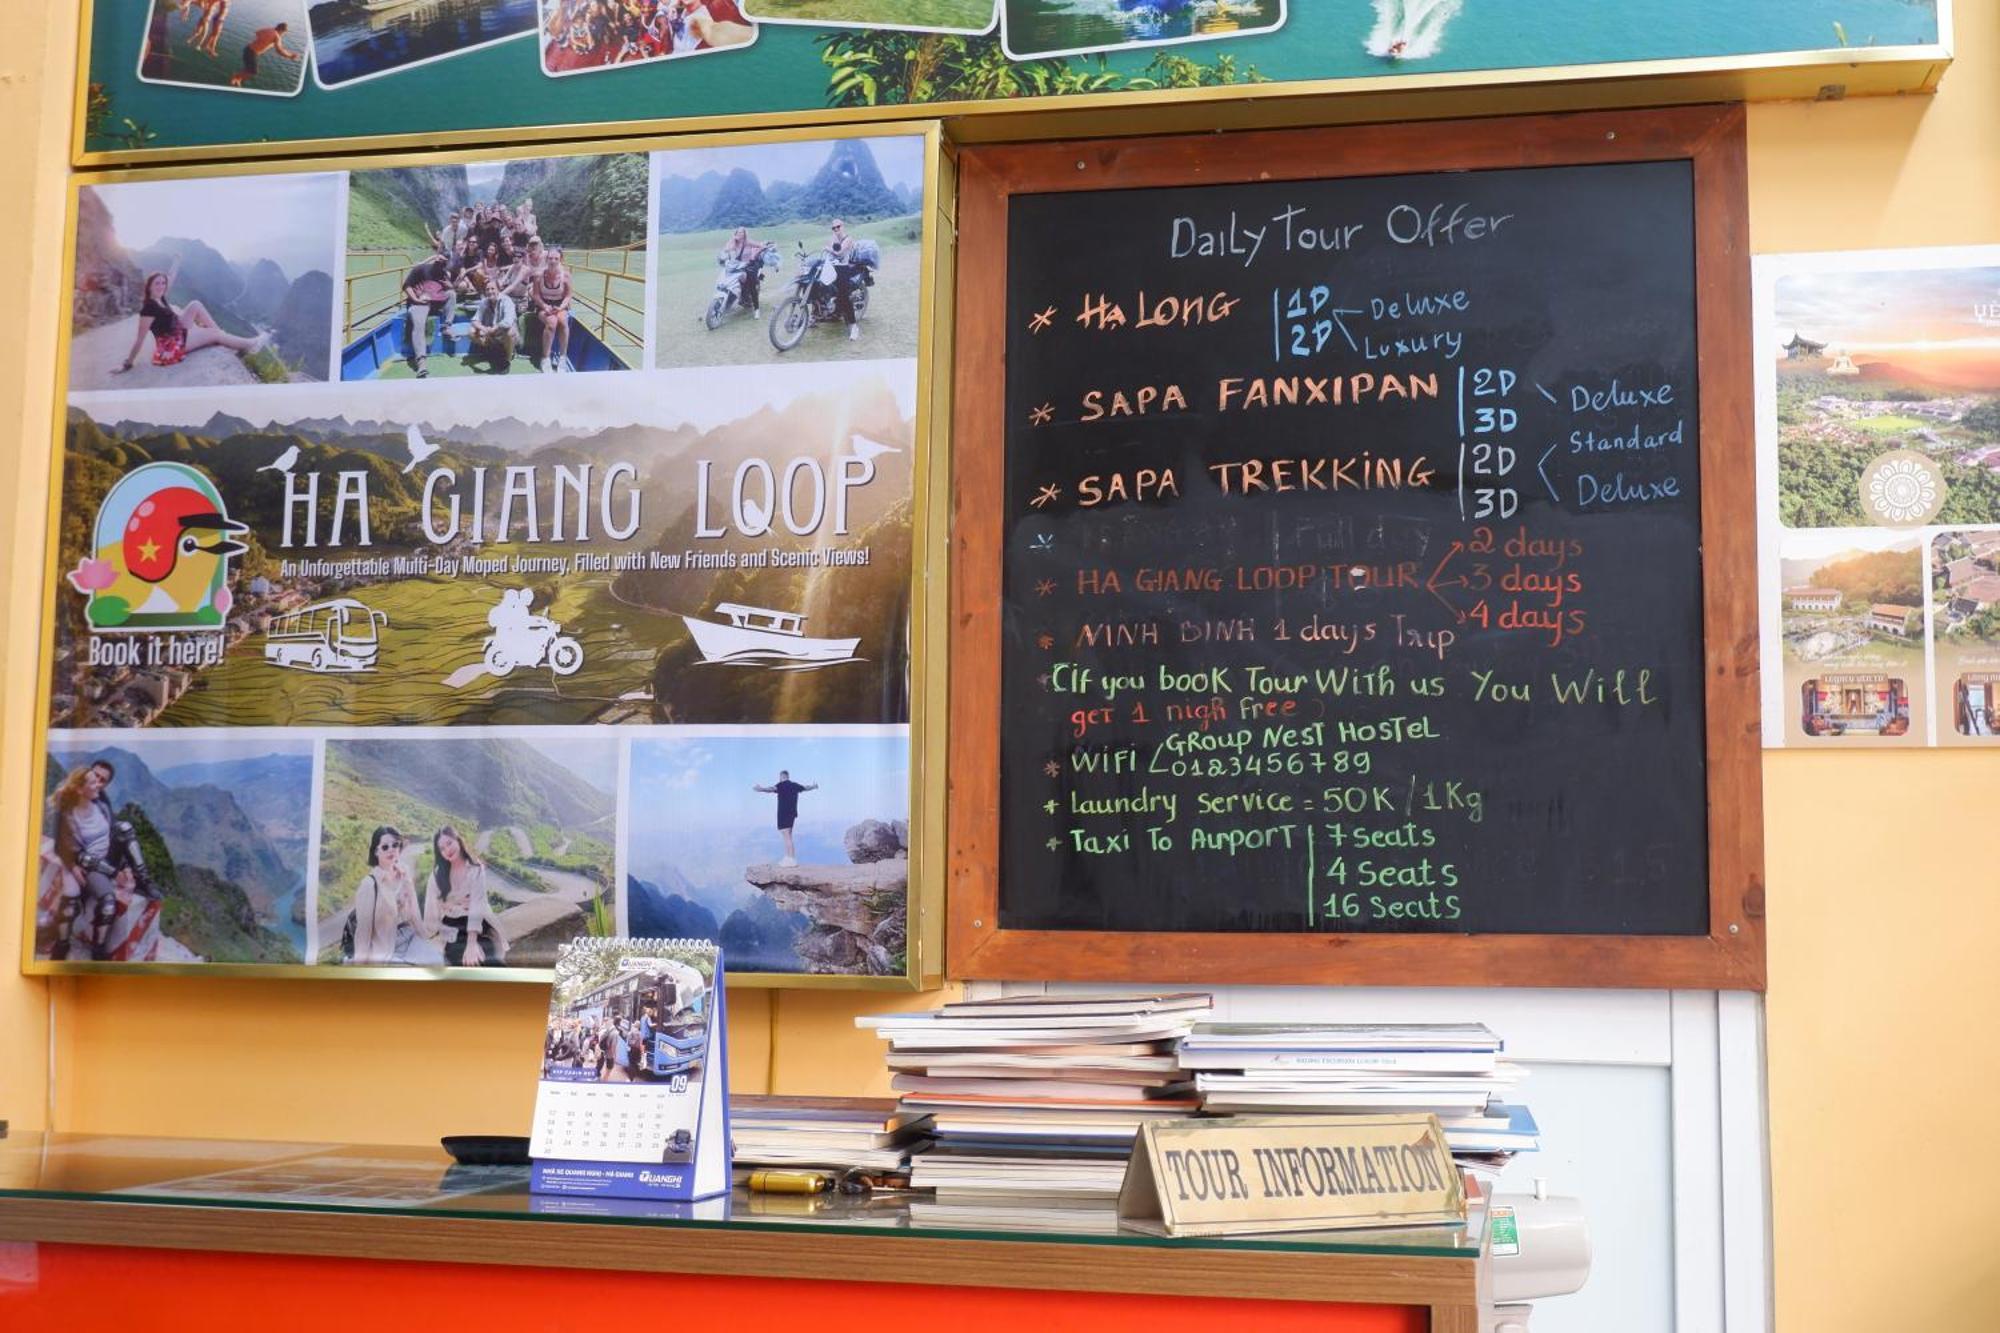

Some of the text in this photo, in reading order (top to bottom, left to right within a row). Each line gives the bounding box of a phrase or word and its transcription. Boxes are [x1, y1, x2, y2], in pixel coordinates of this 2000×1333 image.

[1272, 204, 1363, 250] Tour
[1387, 203, 1514, 246] Offer
[1287, 285, 1330, 318] 1D
[1371, 287, 1471, 320] Deluxe
[1290, 319, 1332, 356] 2D
[1365, 330, 1462, 359] Luxury
[1081, 373, 1439, 423] SAPA FANXIPAN
[1474, 368, 1516, 396] 2D
[1571, 379, 1675, 412] Deluxe
[1474, 407, 1518, 432] 3D
[1570, 420, 1683, 453] Standard
[1472, 444, 1516, 475] 2D
[1078, 469, 1179, 506] SAPA
[1474, 489, 1518, 519] 3D
[1578, 473, 1680, 505] Deluxe
[280, 470, 373, 548] HA
[422, 462, 640, 545] GIANG
[280, 559, 297, 577] An
[300, 557, 389, 579] Unforgettable
[393, 556, 460, 578] Multi-Day
[463, 554, 508, 578] Moped
[574, 552, 610, 572] Filled
[614, 551, 646, 571] with
[651, 550, 681, 569] New
[685, 549, 737, 569] Friends
[740, 548, 767, 568] and
[771, 547, 819, 567] Scenic
[822, 546, 871, 567] Views!
[1470, 527, 1496, 554] 2
[1504, 526, 1583, 571] days
[1077, 562, 1418, 594] HA GIANG LOOP TOUR
[1471, 563, 1582, 607] 3 days
[1076, 622, 1158, 647] NINH
[1273, 619, 1291, 641] 1
[1300, 614, 1376, 654] days
[1470, 600, 1587, 647] 4 days
[89, 634, 225, 666] Book it here!
[1102, 672, 1145, 700] you
[1245, 665, 1308, 696] Tour
[1410, 675, 1445, 697] us
[1471, 669, 1531, 702] You
[1552, 668, 1657, 705] Will
[1132, 702, 1151, 723] 1
[1171, 750, 1371, 777] 0123456789
[1071, 786, 1177, 823] Laundry
[1324, 786, 1395, 813] 50K
[1070, 828, 1130, 854] Taxi
[1147, 826, 1172, 851] To
[1325, 823, 1348, 847] 7
[1326, 856, 1459, 887] 4 Seats
[1323, 891, 1462, 919] 16 Seats
[669, 1075, 688, 1093] 09
[1165, 1143, 1446, 1200] TOUR INFORMATION
